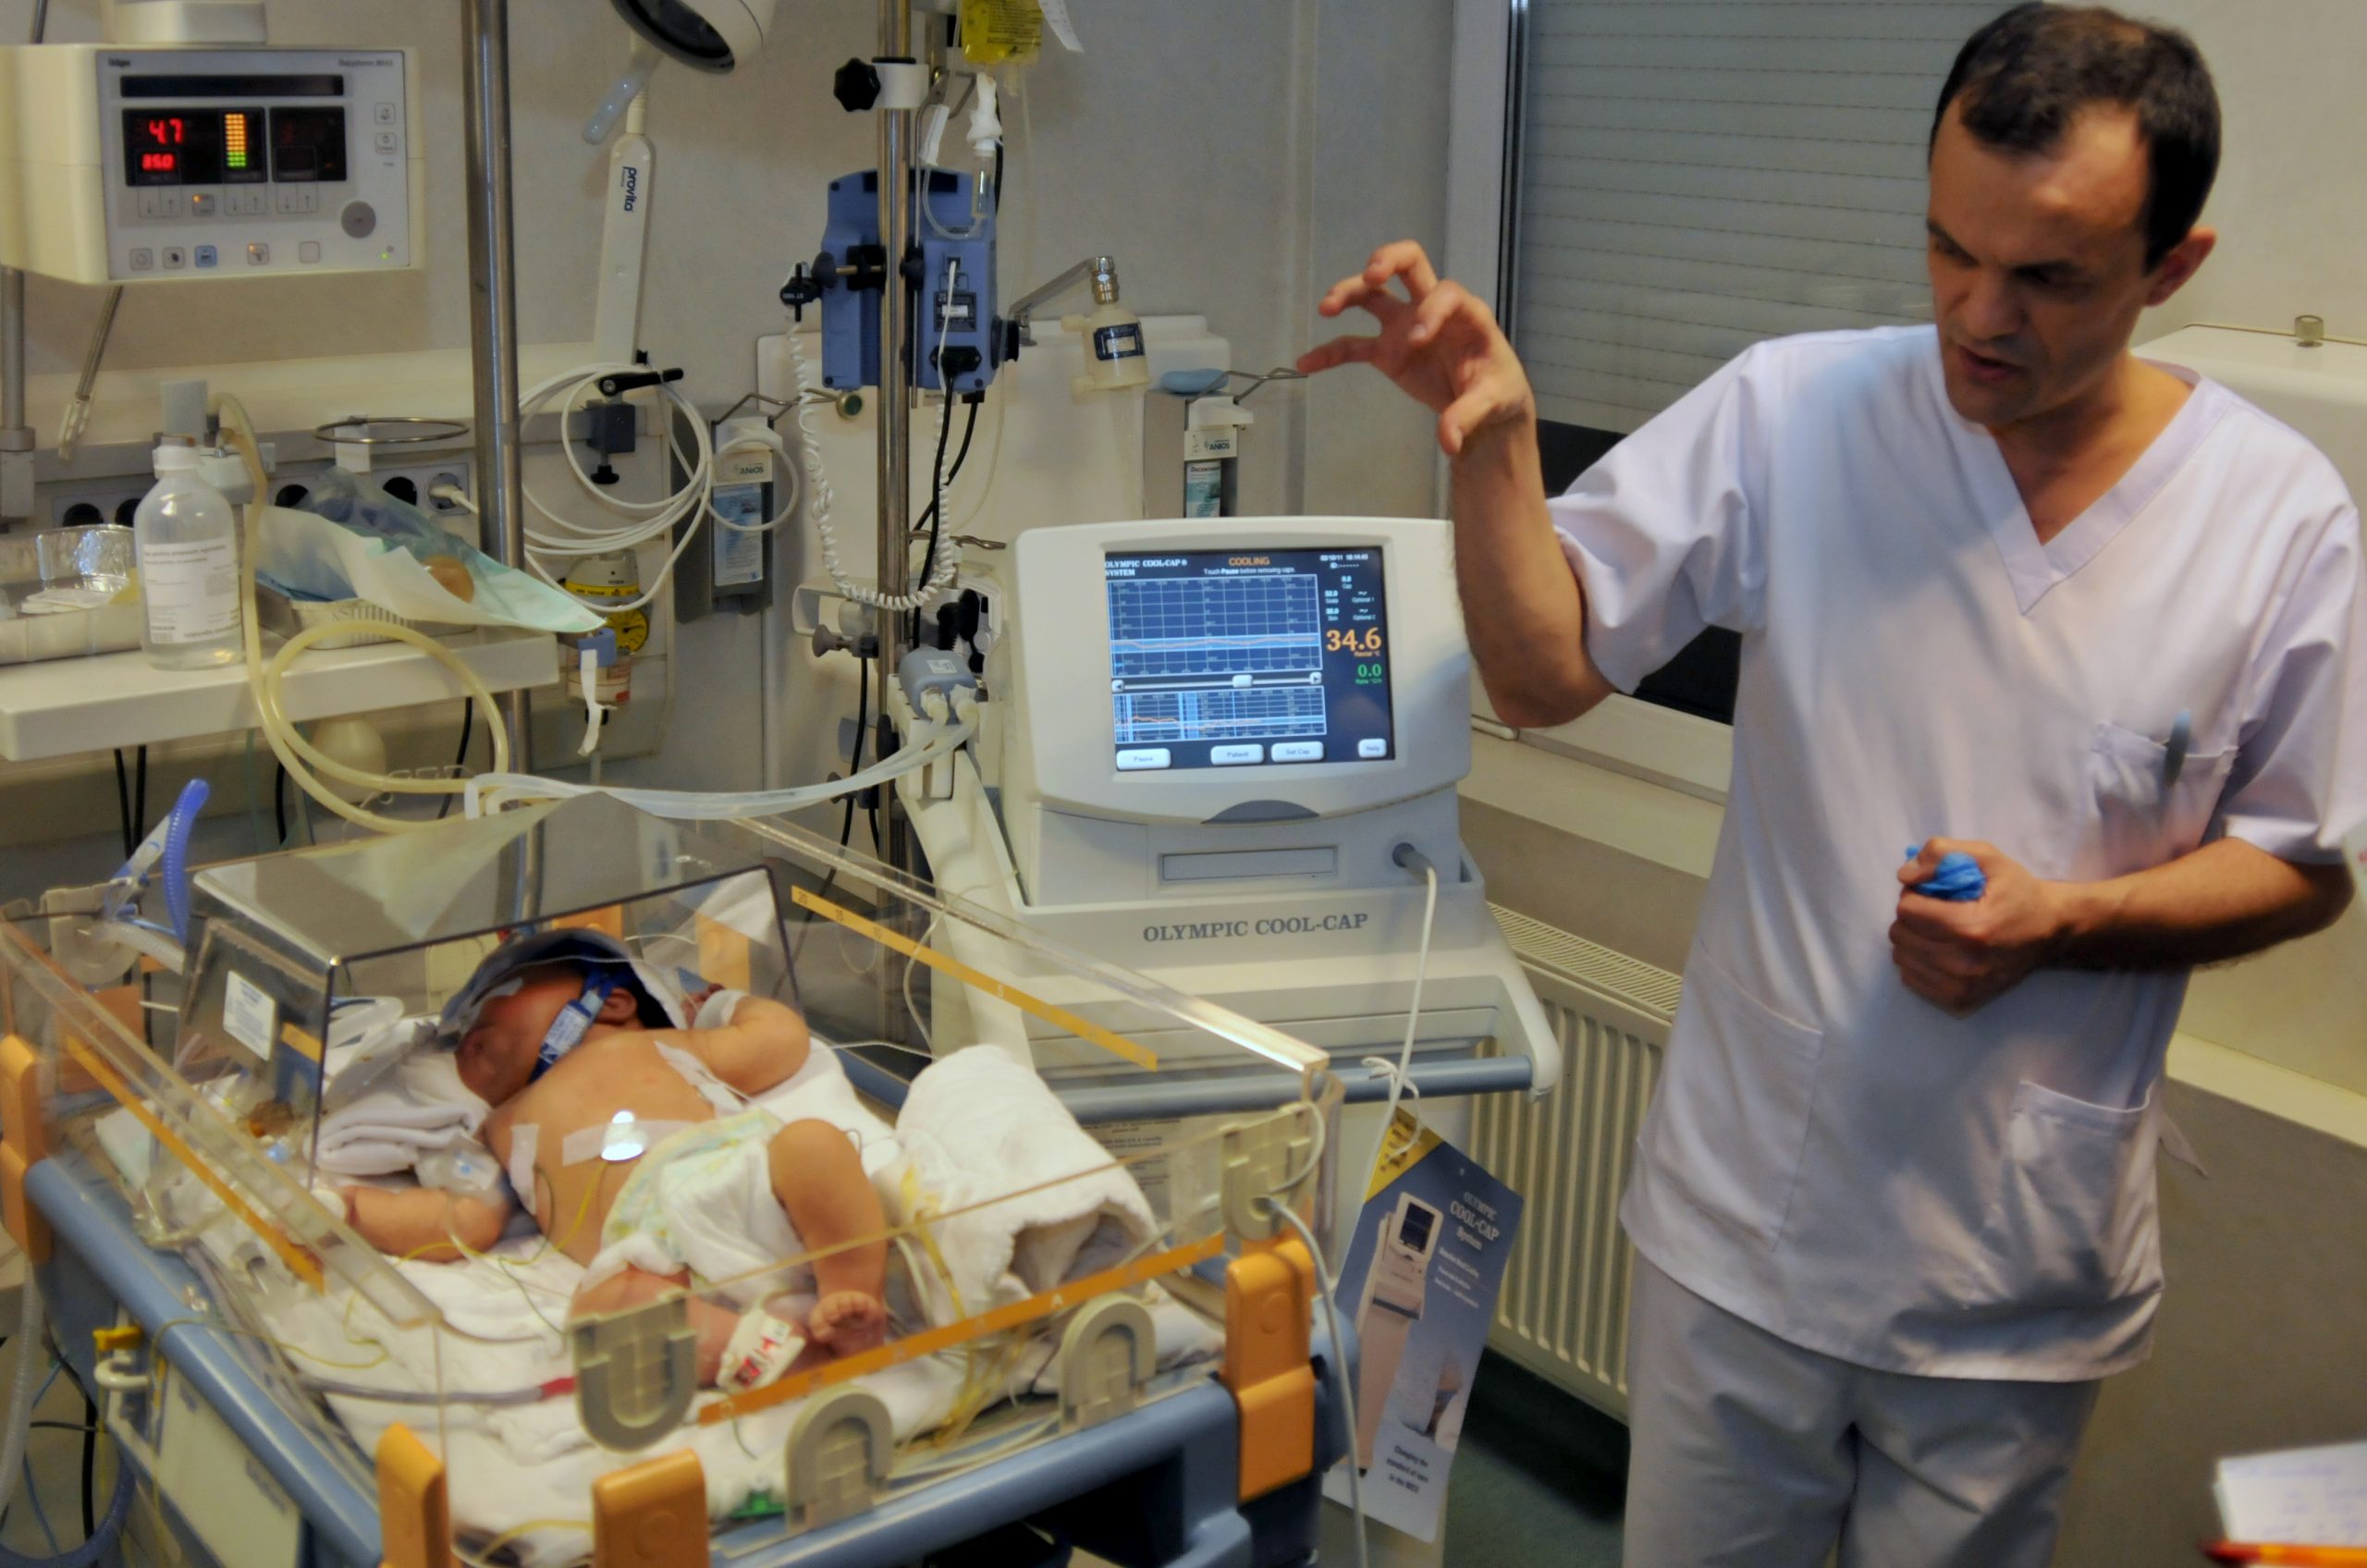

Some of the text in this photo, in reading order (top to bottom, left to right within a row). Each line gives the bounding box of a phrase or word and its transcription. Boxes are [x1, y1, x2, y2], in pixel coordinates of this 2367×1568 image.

[622, 166, 637, 212] provita
[740, 465, 765, 474] ANIOS
[1104, 560, 1140, 569] OLYMPIC
[1228, 557, 1270, 566] COOLING
[1326, 627, 1382, 652] 34.6
[1357, 663, 1382, 678] 0.0
[1143, 913, 1368, 942] OLYMPIC COOL-CAP
[1450, 1200, 1500, 1241] COOL-CAP
